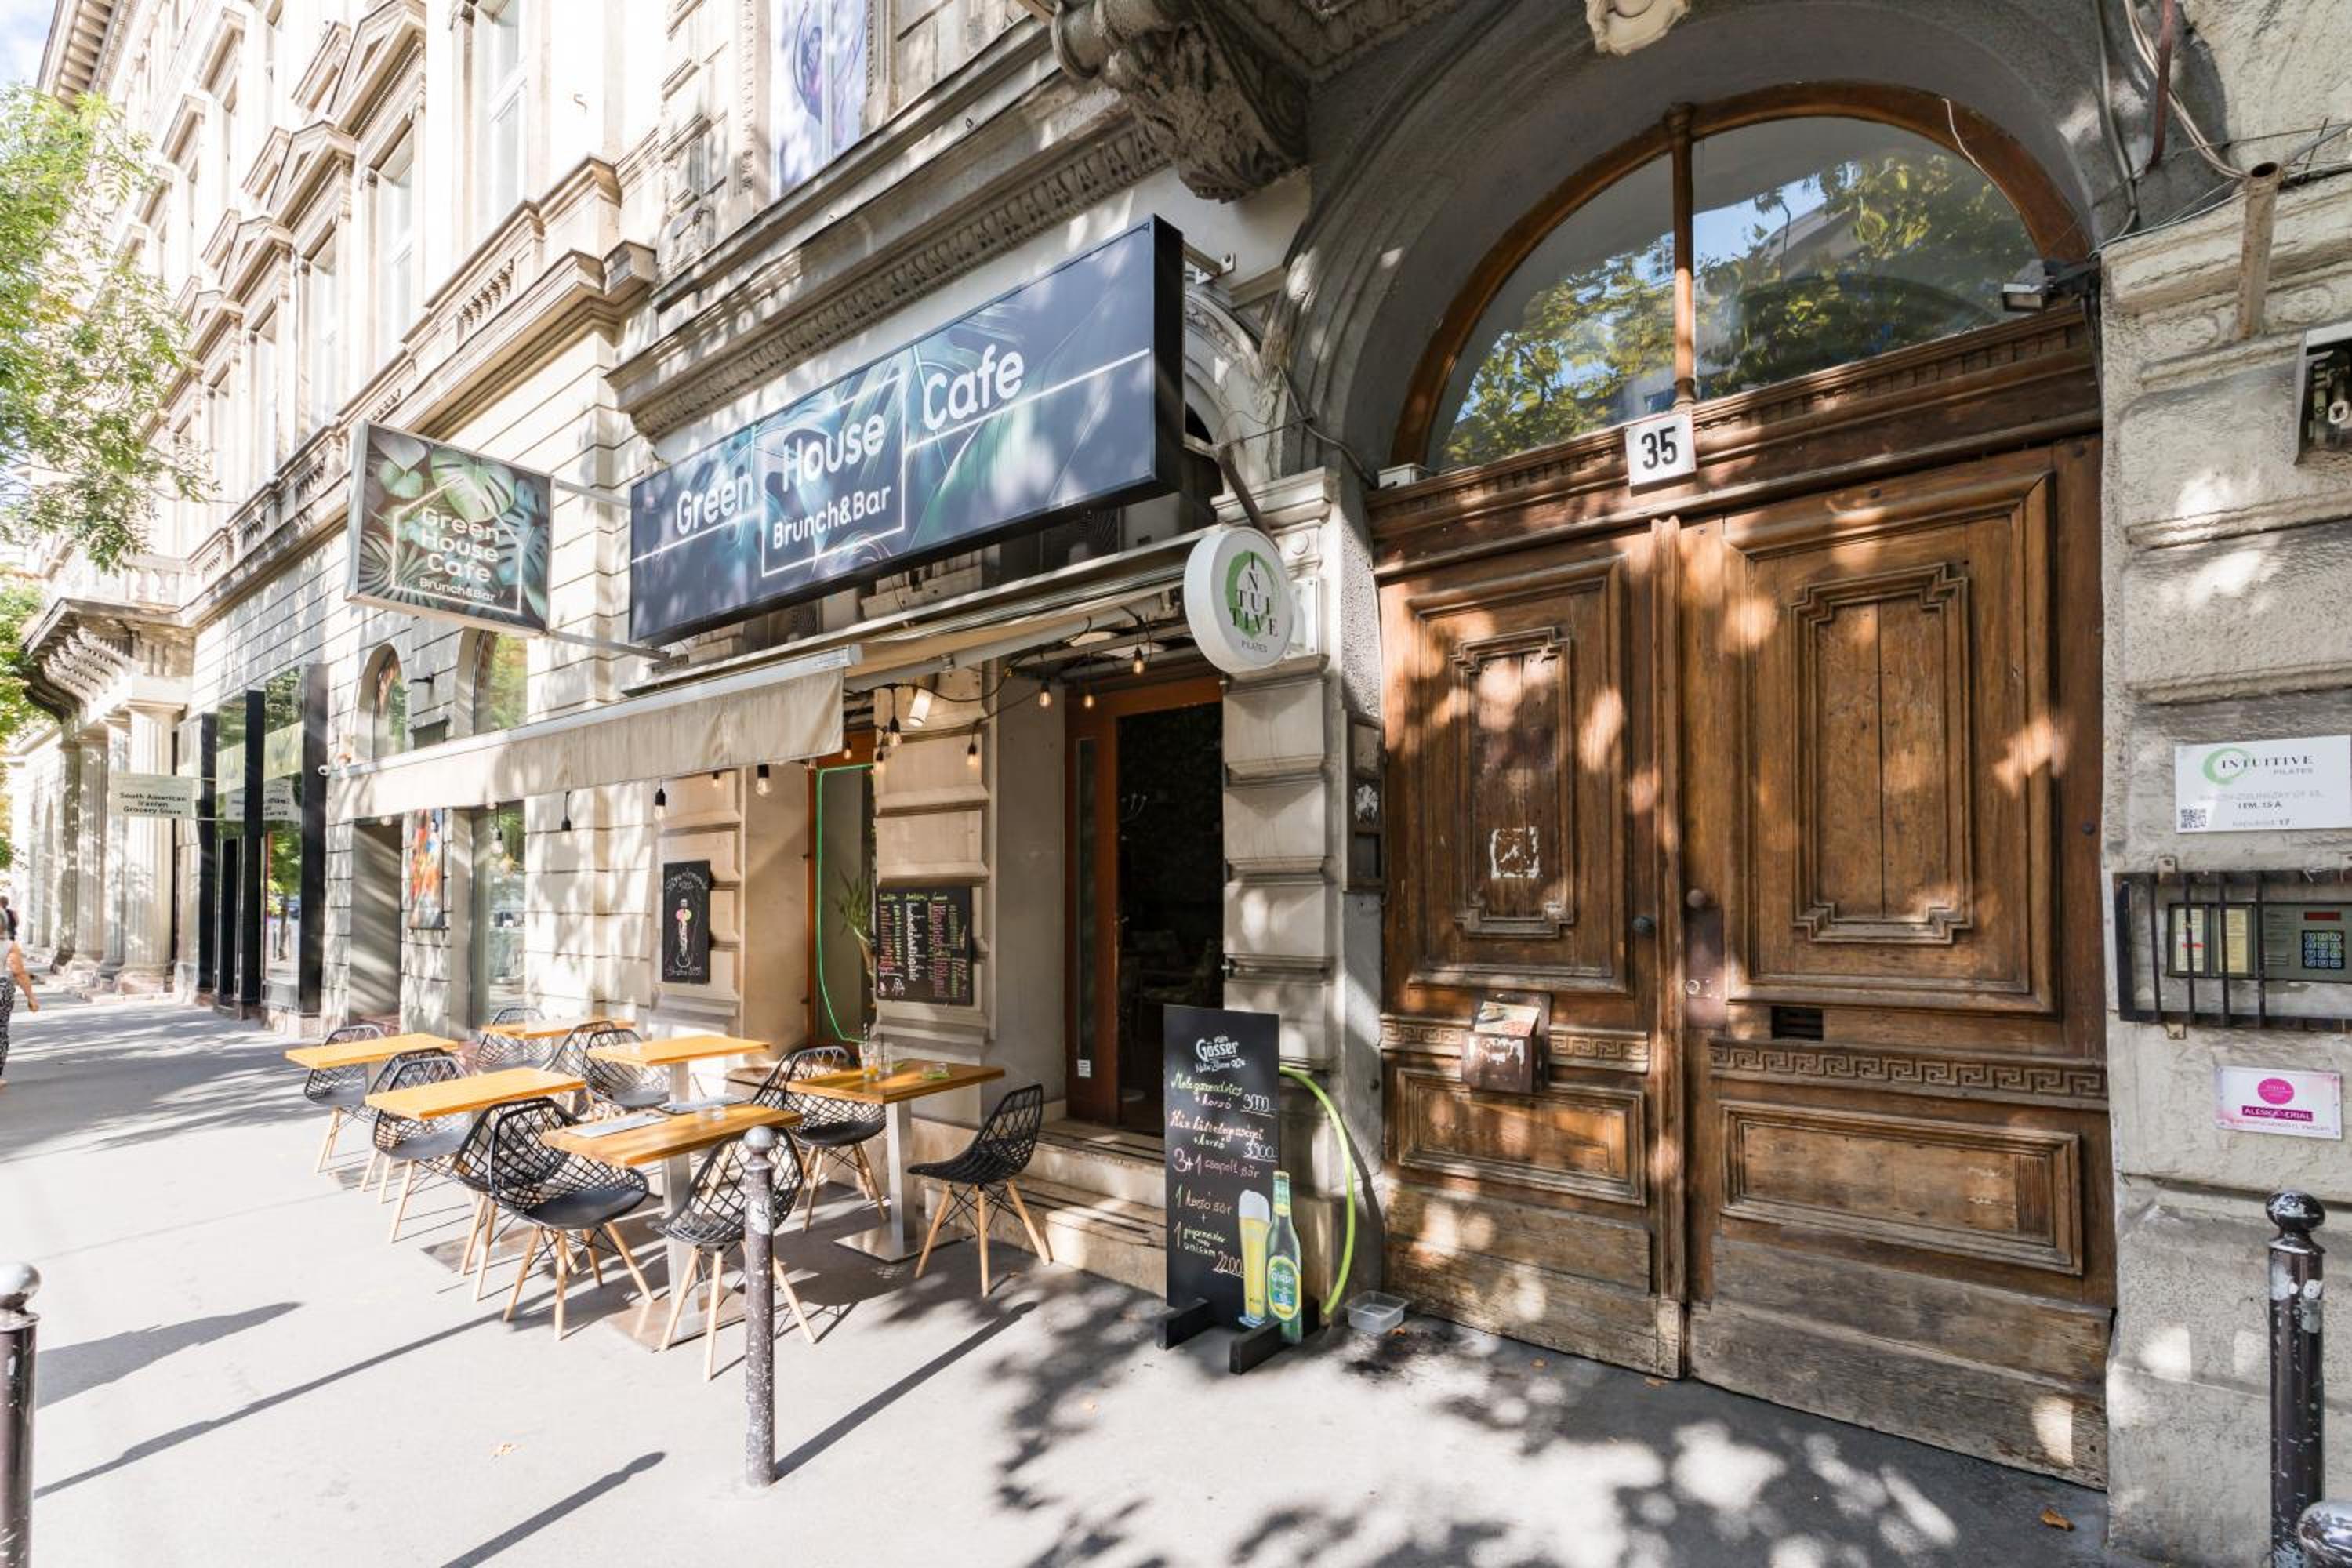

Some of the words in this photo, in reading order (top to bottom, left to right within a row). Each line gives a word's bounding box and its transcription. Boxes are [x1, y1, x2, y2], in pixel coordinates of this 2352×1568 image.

[677, 472, 753, 532] Green
[782, 413, 886, 492] House
[922, 343, 1025, 430] Cafe
[1641, 426, 1679, 470] 35
[421, 506, 499, 543] Green
[773, 486, 891, 550] Brunch&Bar
[422, 530, 499, 562] House
[427, 553, 491, 583] Cafe
[419, 576, 496, 602] Brunch&Bar
[2222, 755, 2314, 769] INTUITIVE
[119, 791, 144, 800] South
[147, 793, 187, 802] American
[123, 806, 158, 815] Grocery
[1196, 1038, 1240, 1062] Gösser
